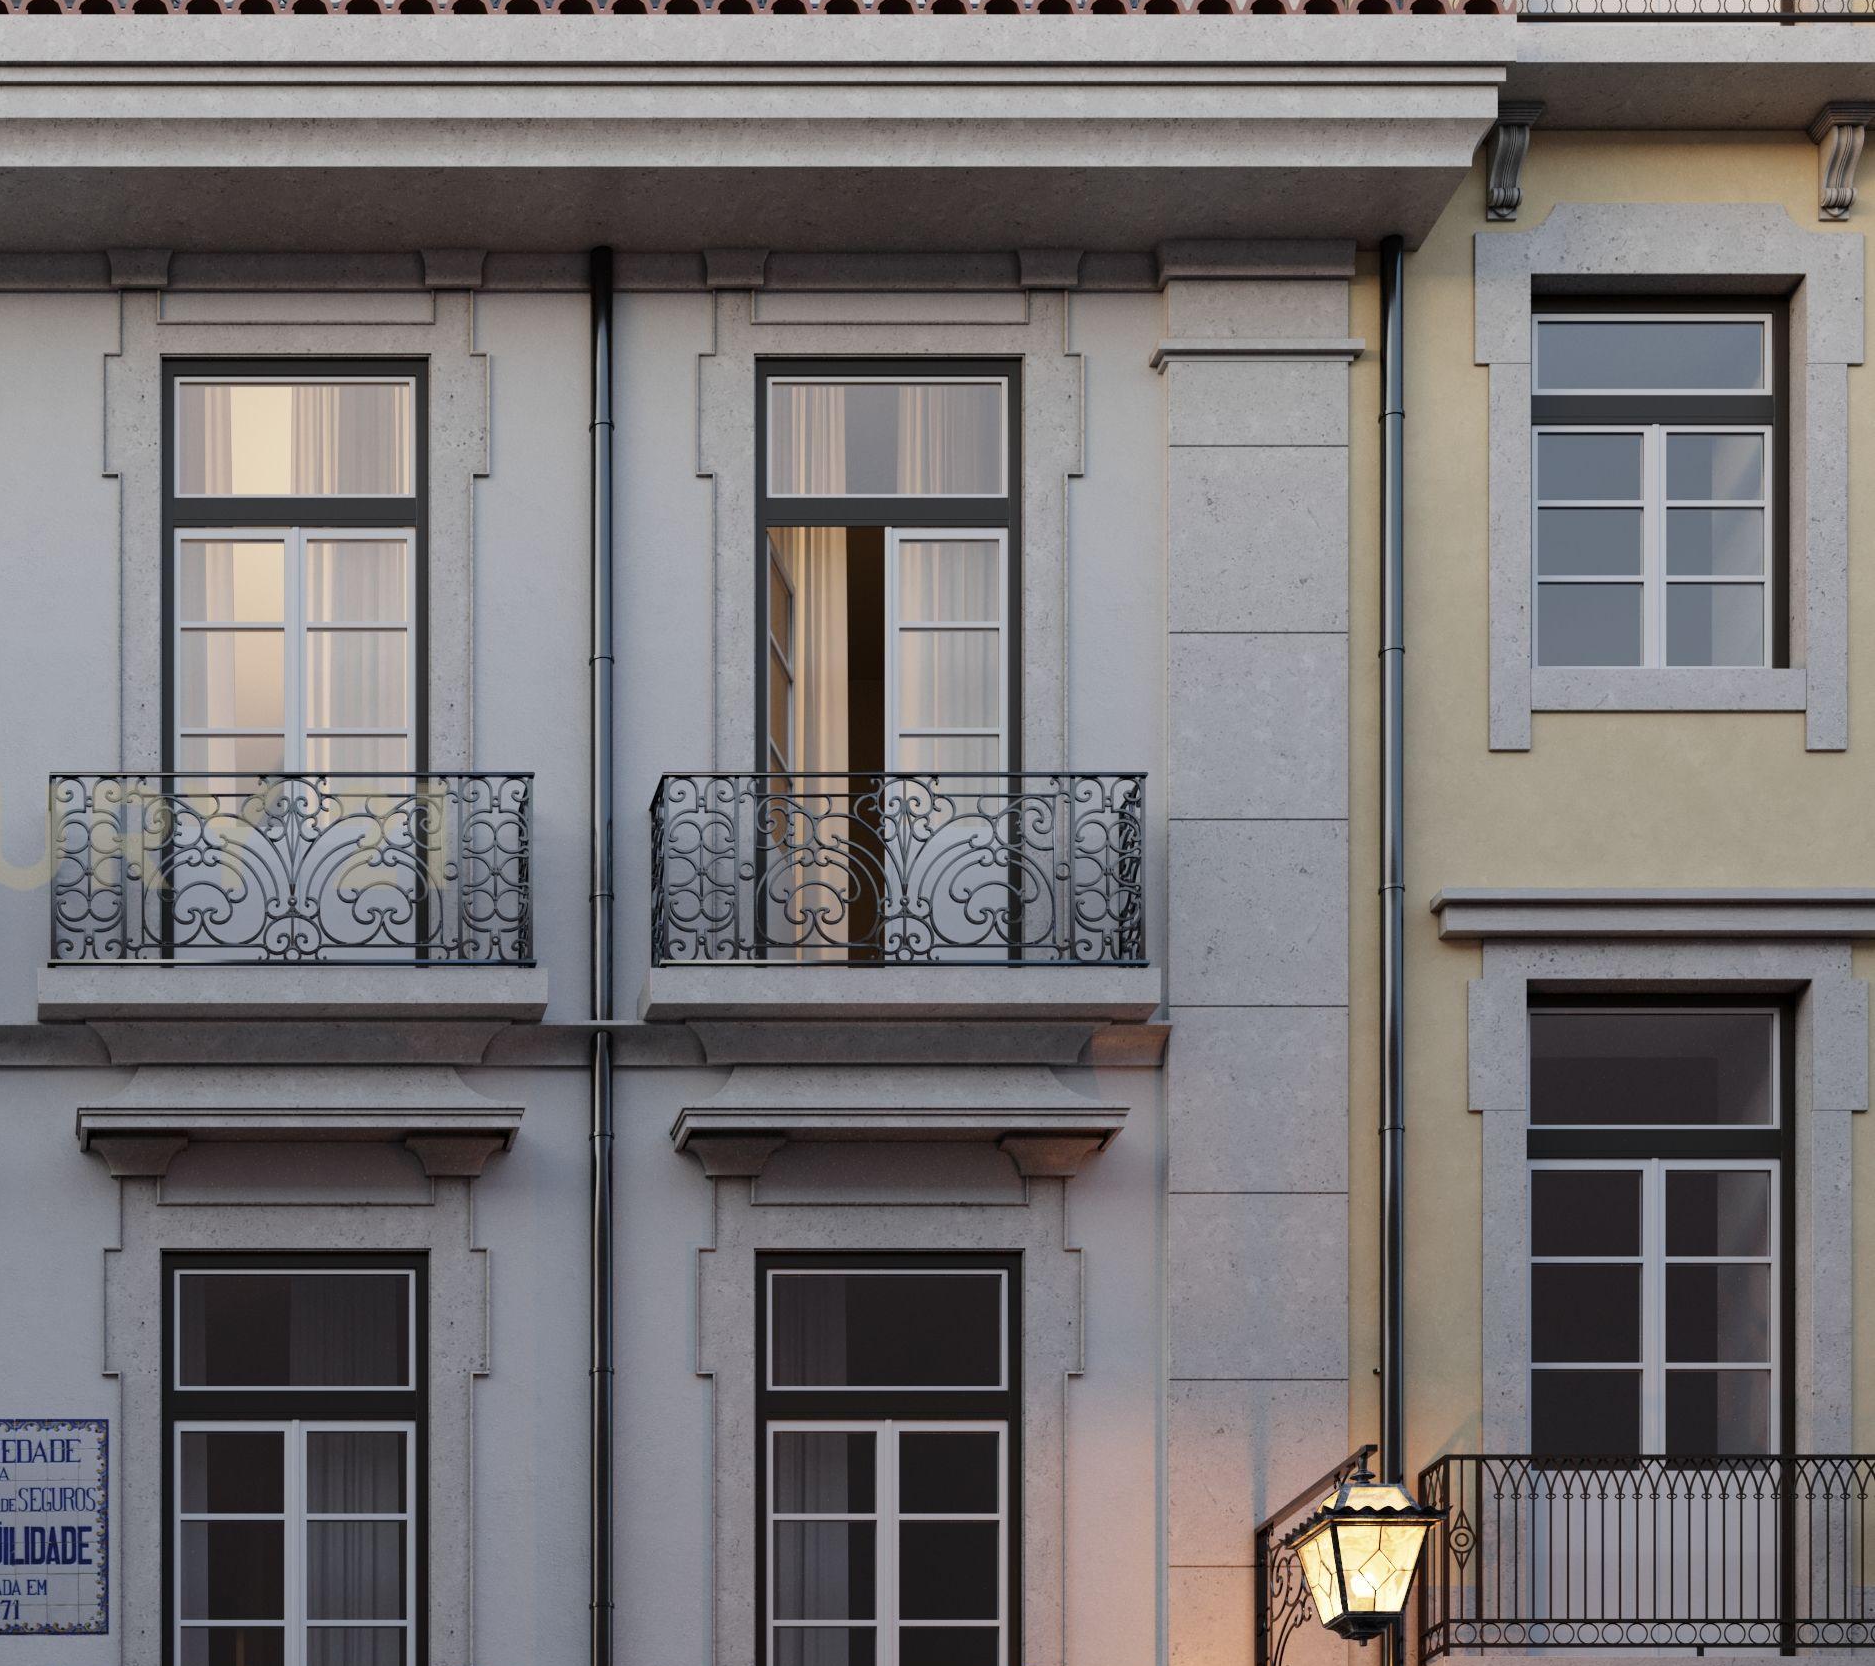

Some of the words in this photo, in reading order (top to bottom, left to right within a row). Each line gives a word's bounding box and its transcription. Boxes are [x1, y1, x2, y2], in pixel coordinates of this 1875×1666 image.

[0, 1498, 17, 1513] DE
[18, 1487, 97, 1513] SEGUROS
[27, 1579, 48, 1596] EM
